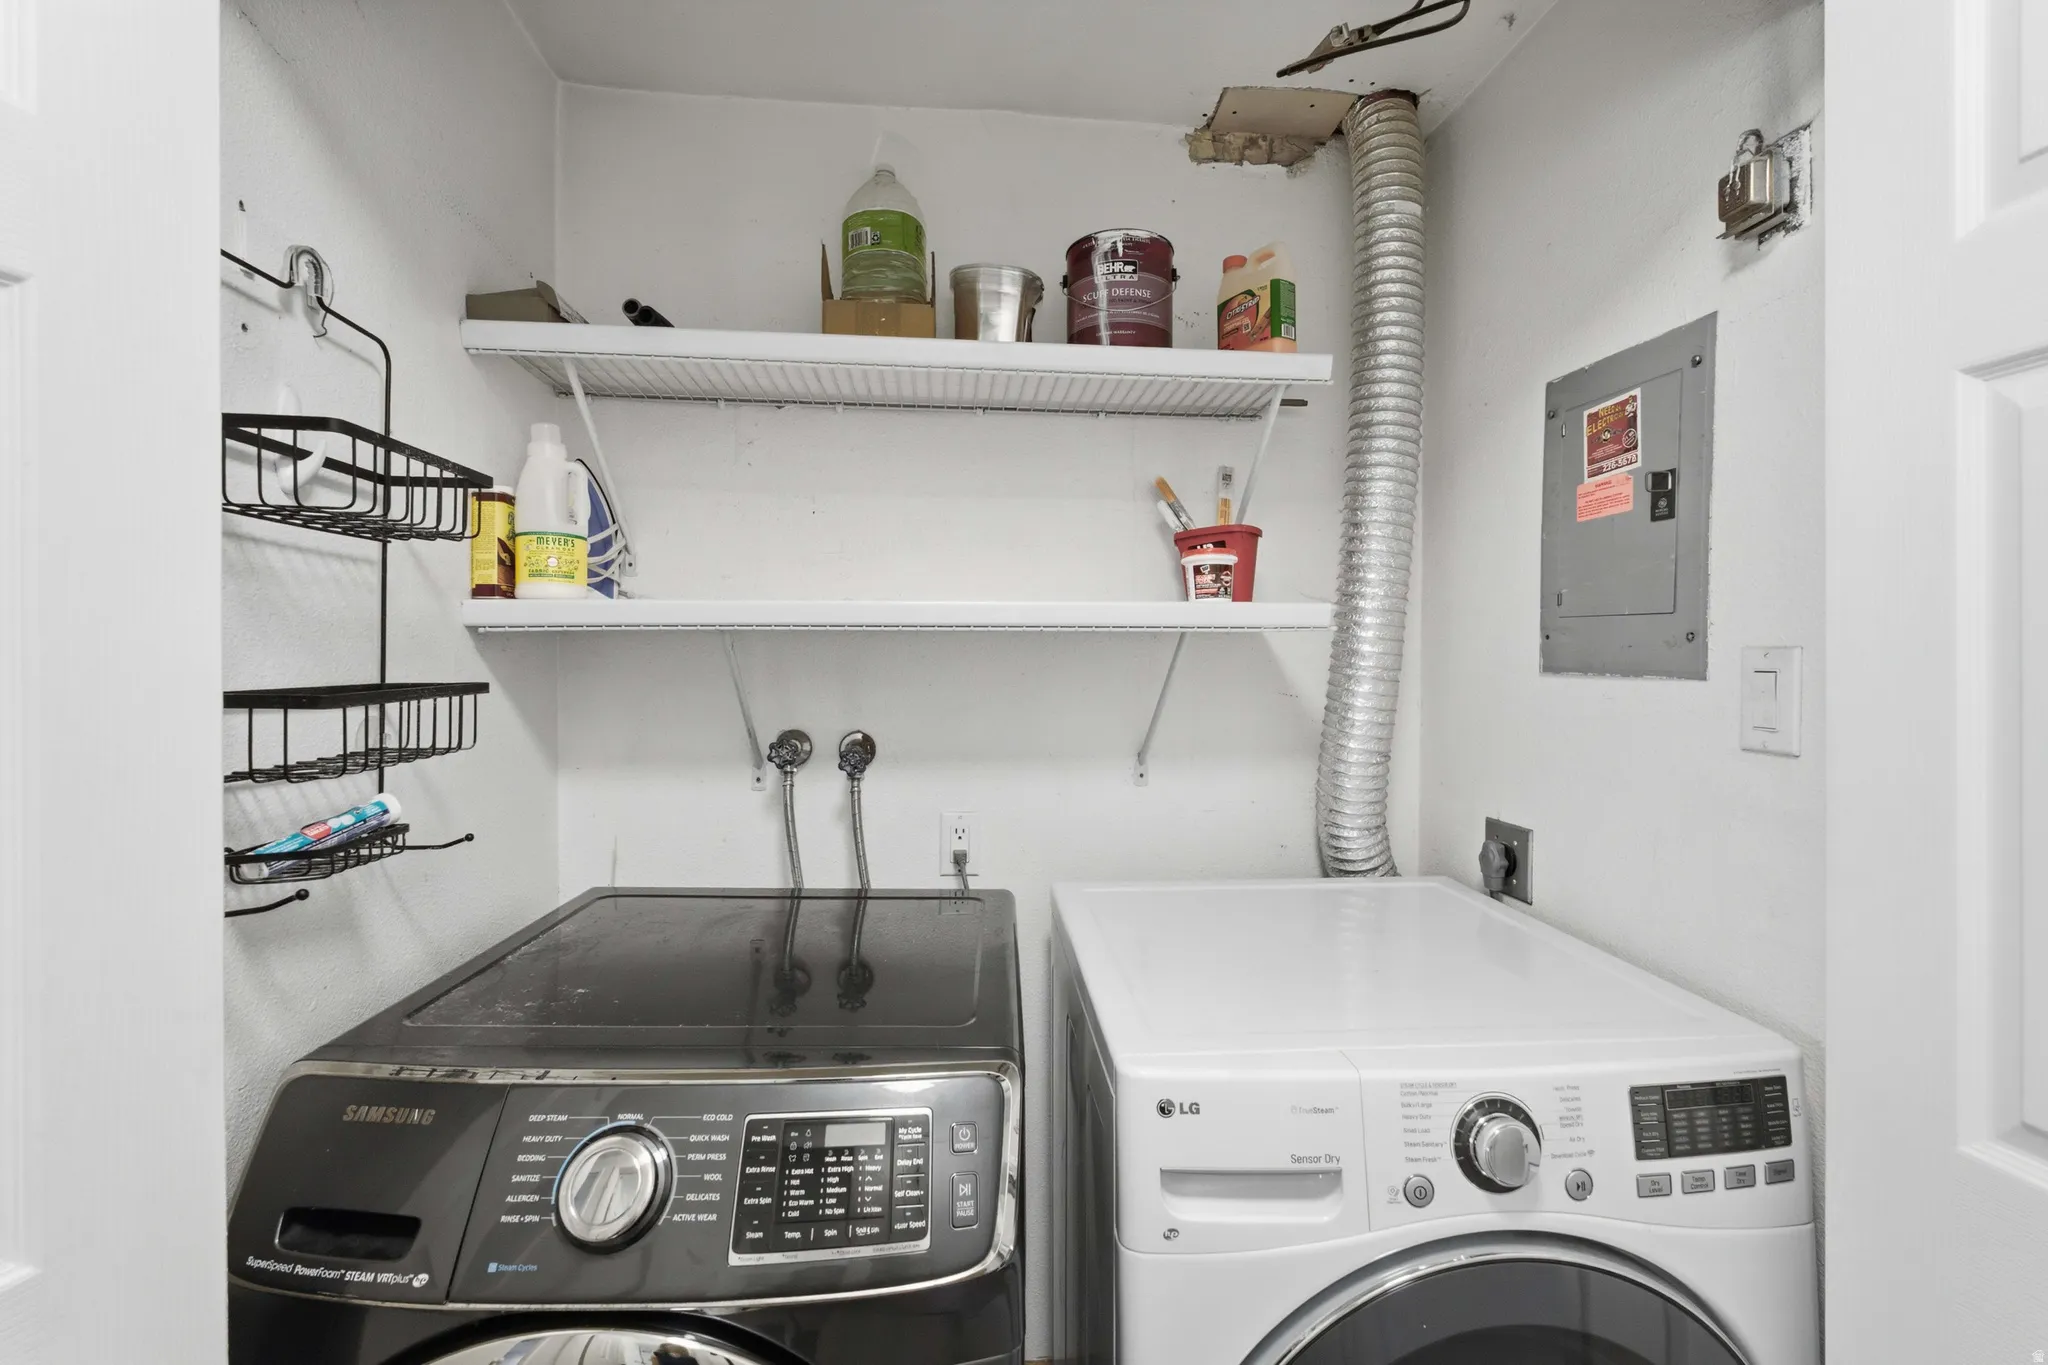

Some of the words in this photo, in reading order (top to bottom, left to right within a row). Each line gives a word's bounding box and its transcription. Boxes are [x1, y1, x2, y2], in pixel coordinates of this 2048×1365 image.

[1097, 262, 1124, 275] BEHR
[1083, 289, 1109, 303] SCUFF
[1111, 288, 1152, 299] DEFENSE
[536, 537, 575, 548] MEYER'S
[1179, 1102, 1201, 1115] LG
[342, 1104, 436, 1125] SAMSUNG
[689, 1134, 711, 1142] QUICK
[711, 1134, 730, 1142] WASH
[762, 1134, 776, 1142] Wash
[687, 1153, 706, 1161] PERM
[707, 1153, 727, 1161] PRESS
[1290, 1153, 1322, 1165] Sensor
[1324, 1153, 1341, 1166] Dry
[897, 1159, 912, 1167] Delay
[511, 1174, 541, 1182] SANITIZE
[686, 1193, 720, 1201] DELICATES
[894, 1190, 906, 1198] Self
[759, 1197, 772, 1205] Spin
[956, 1200, 975, 1208] START
[956, 1209, 975, 1217] PAUSE
[500, 1215, 520, 1223] RINSE
[525, 1215, 541, 1223] SPIN
[672, 1214, 696, 1222] ACTIVE
[696, 1214, 718, 1222] WEAR
[909, 1220, 926, 1229] Speed
[823, 1229, 837, 1237] Spin
[246, 1256, 294, 1273] SuperSpeed
[294, 1264, 341, 1279] PowerFoam
[344, 1271, 375, 1282] STEAM
[377, 1273, 411, 1285] VRTplus
